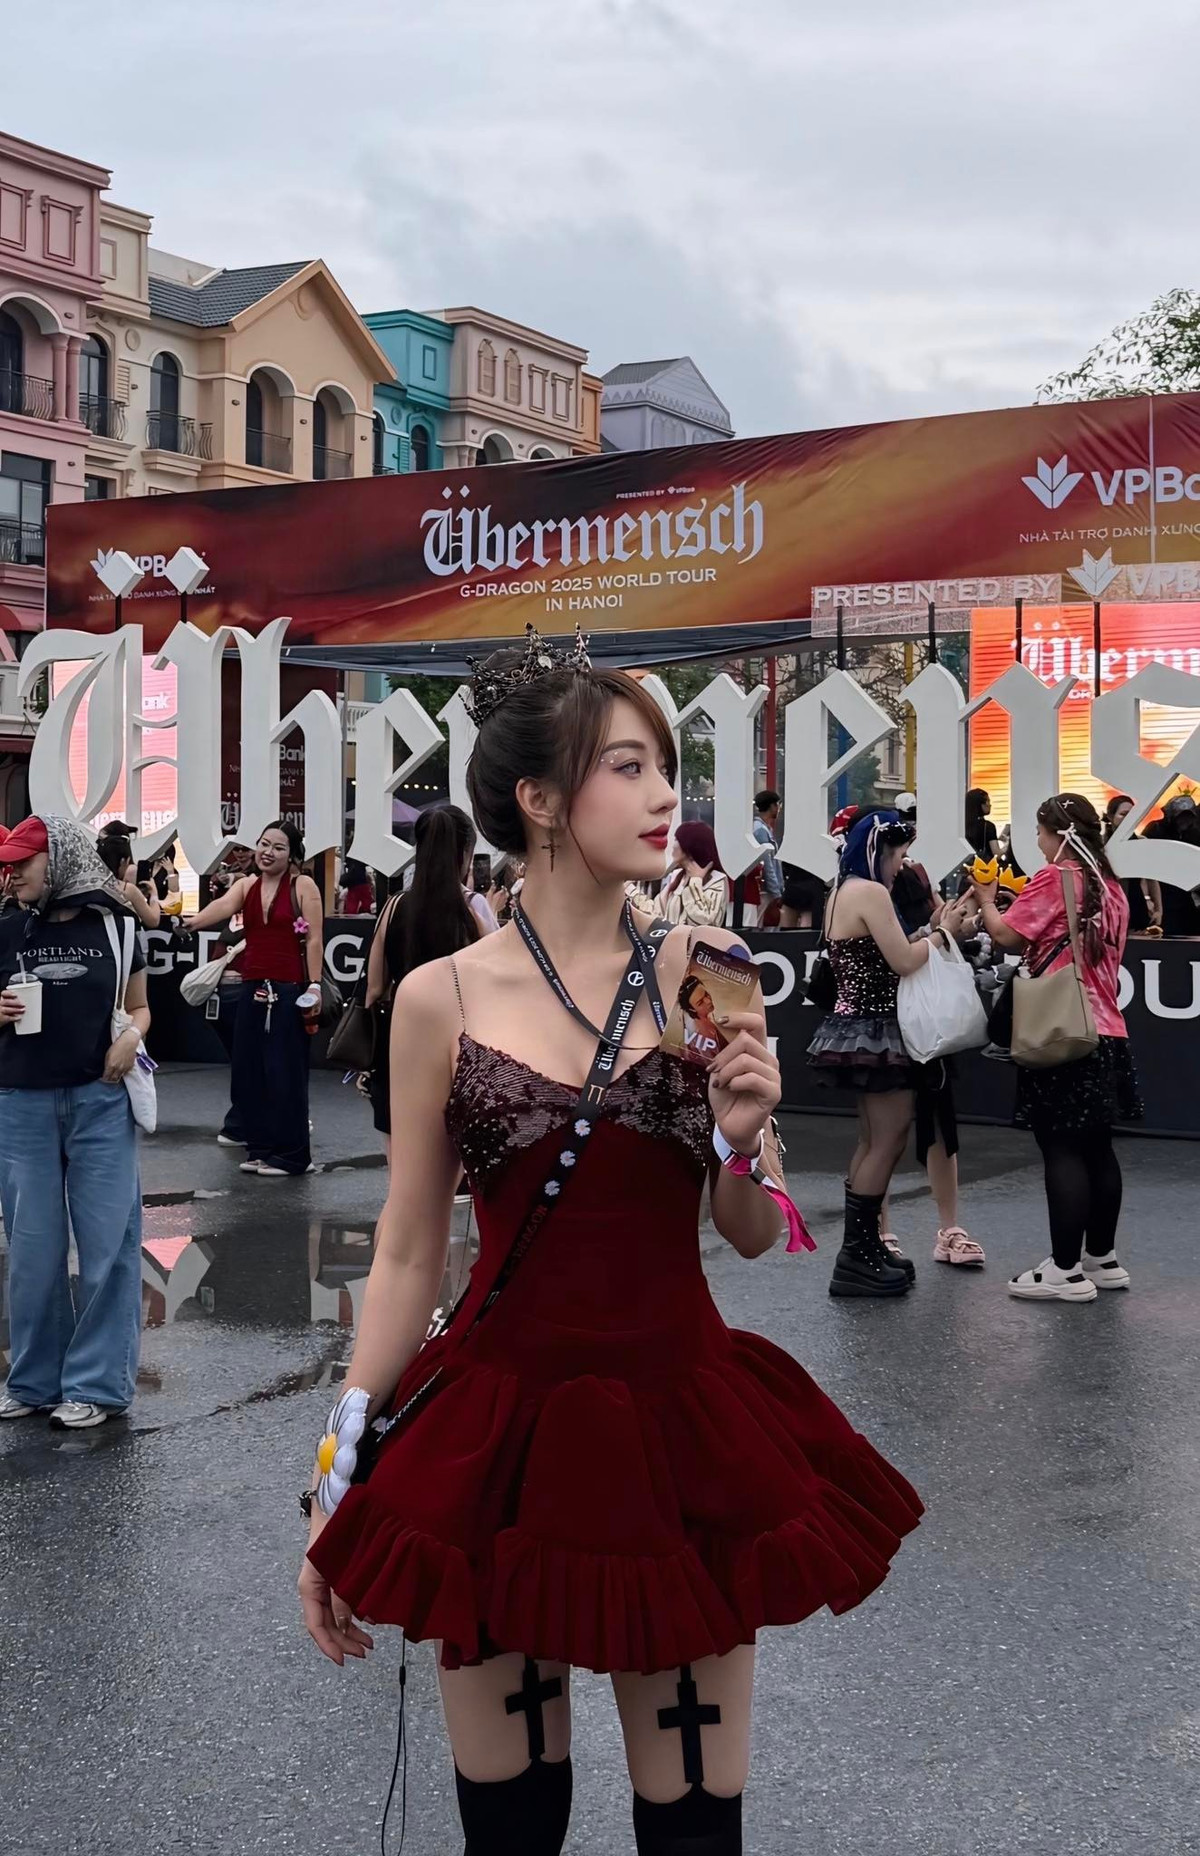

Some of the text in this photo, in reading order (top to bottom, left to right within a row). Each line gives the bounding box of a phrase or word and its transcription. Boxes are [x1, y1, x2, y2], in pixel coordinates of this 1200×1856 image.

[420, 480, 764, 577] Übermensch
[1019, 528, 1050, 543] NHÀ
[1053, 528, 1074, 541] TÀI
[1078, 526, 1109, 541] TRỢ
[460, 568, 717, 598] G-DRAGON 2025 WORLD TOUR
[814, 576, 1058, 608] PRESENTED BY
[1126, 564, 1200, 598] VPB
[545, 594, 623, 612] IN HANOI
[22, 946, 103, 958] ORTLAND
[696, 949, 752, 987] Übermensch
[596, 999, 636, 1071] Übemensch
[683, 1028, 718, 1053] VIP
